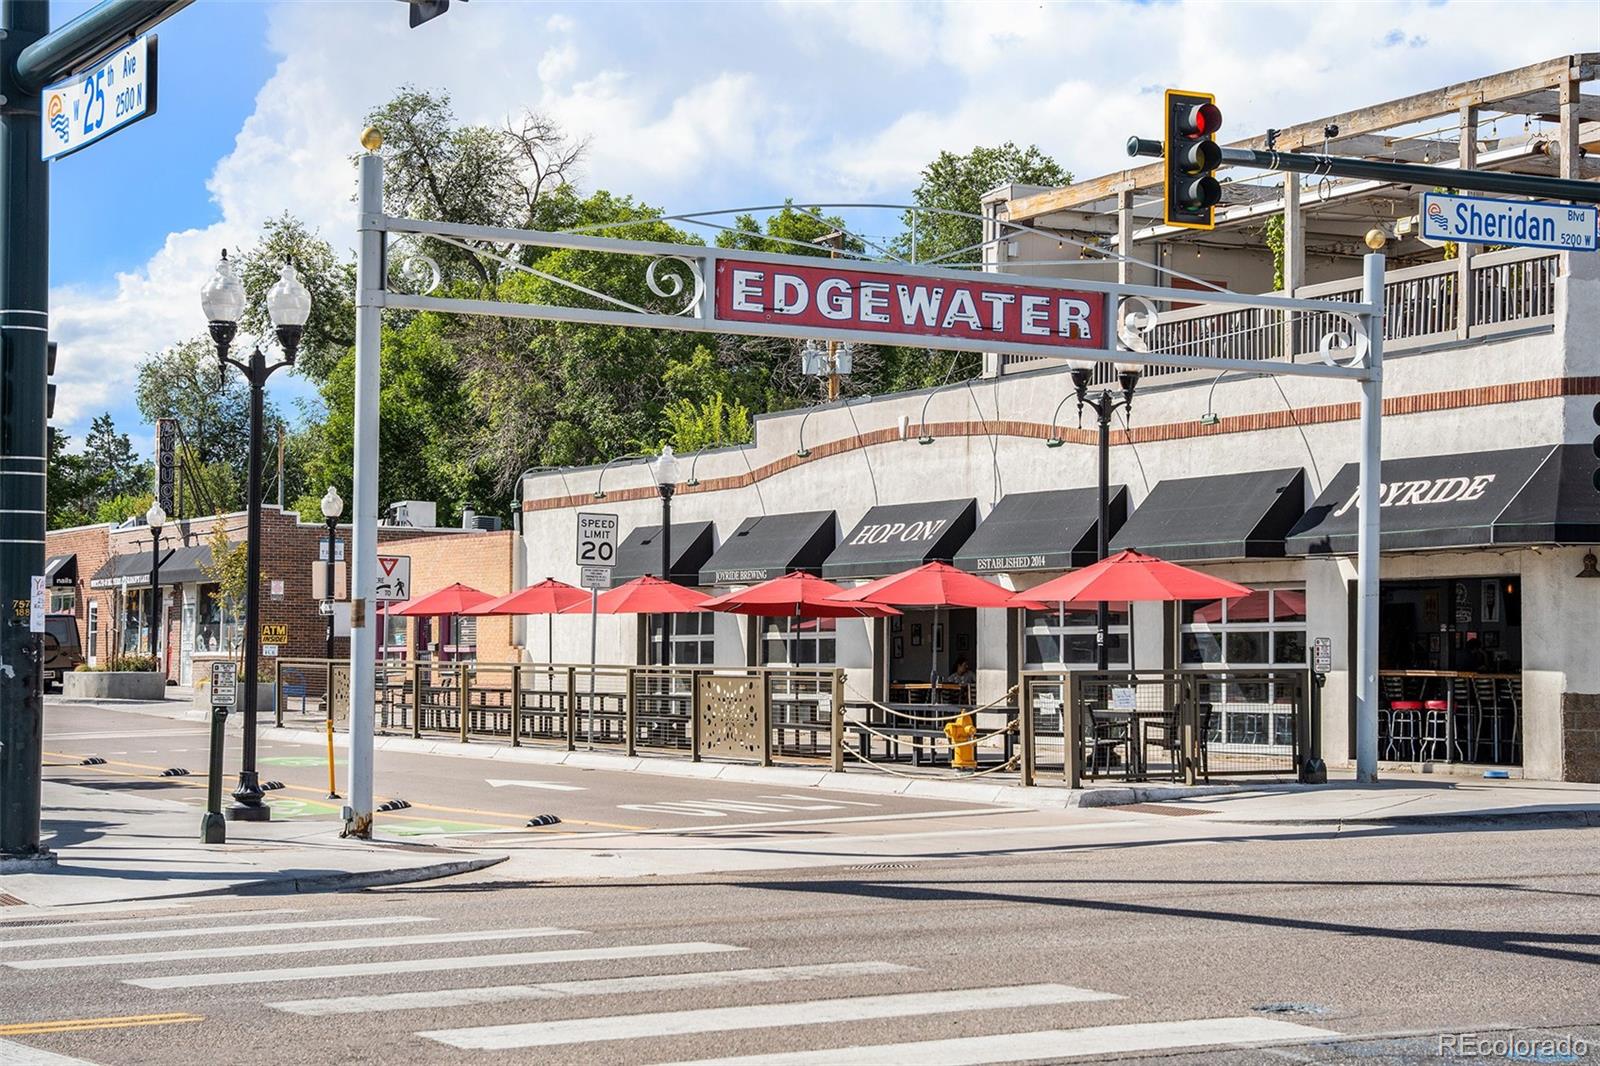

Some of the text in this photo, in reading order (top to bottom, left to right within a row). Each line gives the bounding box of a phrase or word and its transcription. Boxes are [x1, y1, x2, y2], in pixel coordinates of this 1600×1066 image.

[73, 56, 136, 136] W 25 th Ave
[116, 83, 142, 118] 2500 N
[1455, 203, 1585, 242] Sheridan Blvd
[1561, 233, 1591, 246] 5200 W
[732, 270, 1092, 339] EDGEWATER
[1334, 474, 1496, 517] JYRIDE
[581, 519, 615, 529] SPEED
[849, 519, 946, 545] HOP ON!
[584, 530, 610, 539] LIMIT
[581, 541, 613, 561] 20
[977, 555, 1046, 570] ESTABLISHED 2014
[715, 570, 767, 583] JOYRIDE BREWING
[263, 626, 286, 635] ATM
